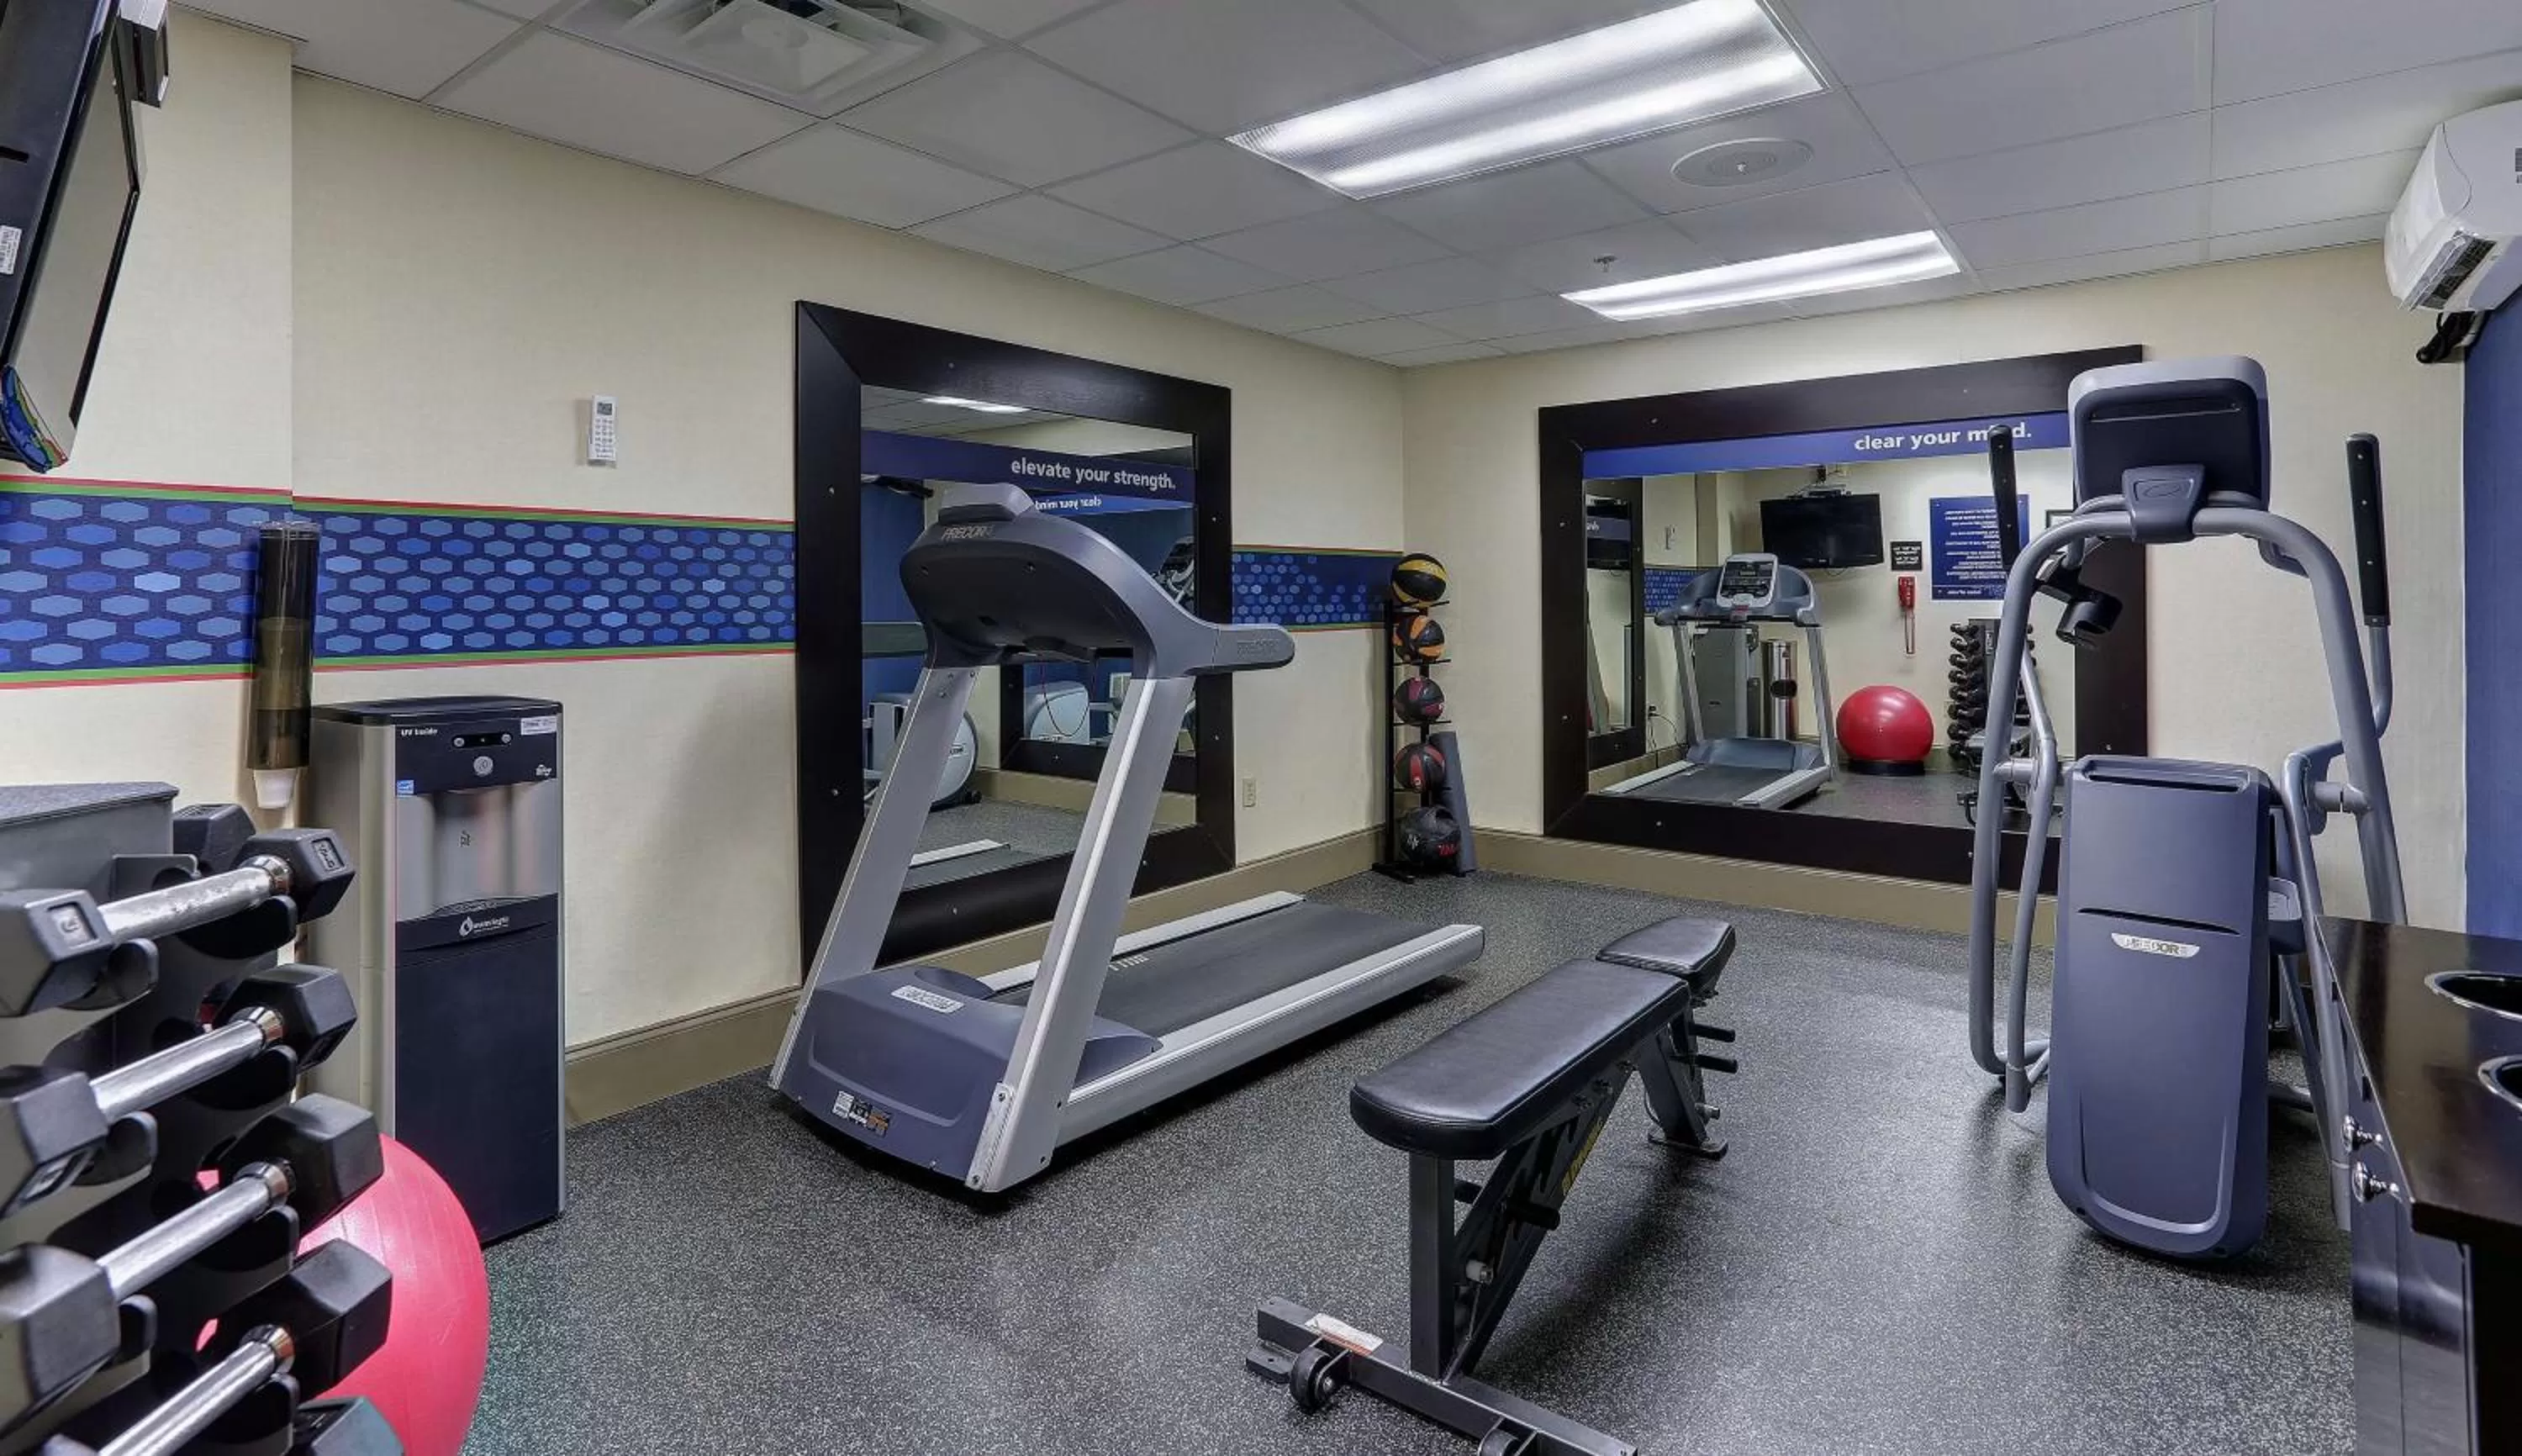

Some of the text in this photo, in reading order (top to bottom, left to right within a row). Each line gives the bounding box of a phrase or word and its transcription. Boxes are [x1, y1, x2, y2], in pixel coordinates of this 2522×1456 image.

[1855, 422, 2032, 451] clear your md.
[1011, 457, 1176, 491] elevate your strength.
